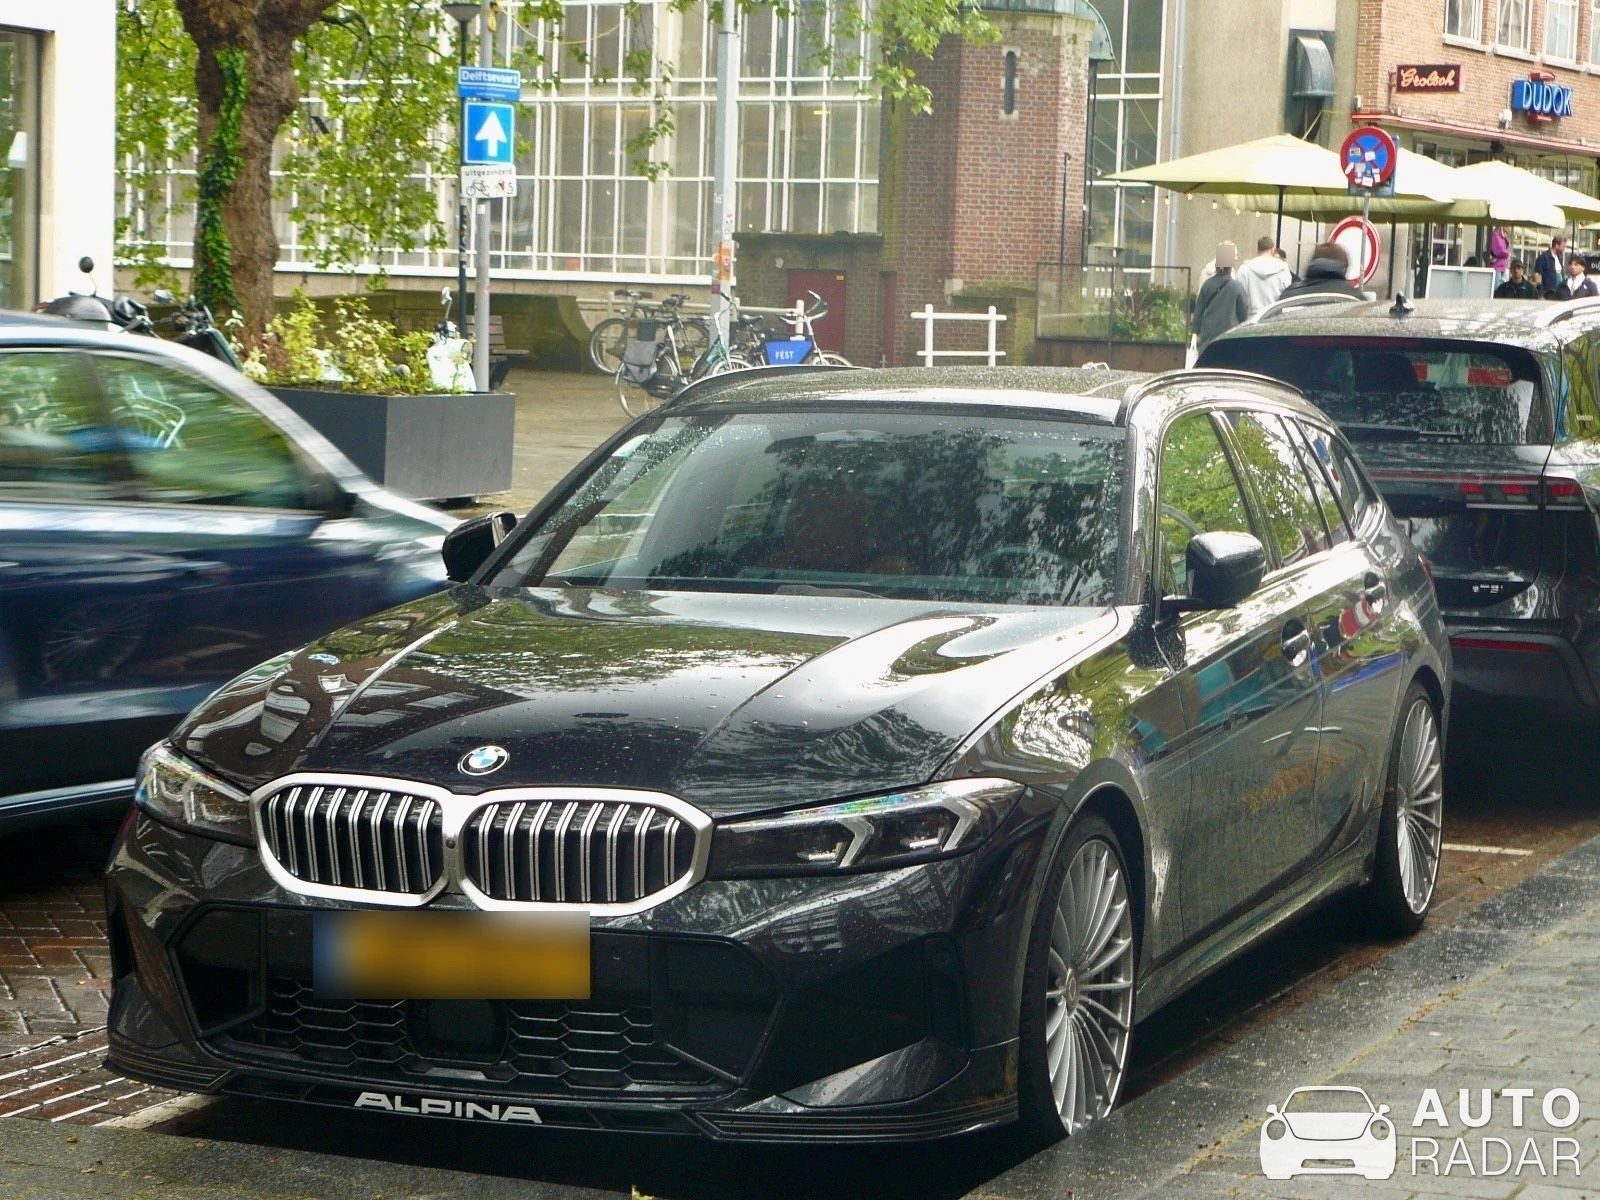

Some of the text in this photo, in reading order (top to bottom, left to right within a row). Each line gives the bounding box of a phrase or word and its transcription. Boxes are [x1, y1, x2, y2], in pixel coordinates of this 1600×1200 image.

[1522, 81, 1572, 116] DUDOK
[775, 350, 794, 360] FEST
[354, 1091, 543, 1124] ALPINA
